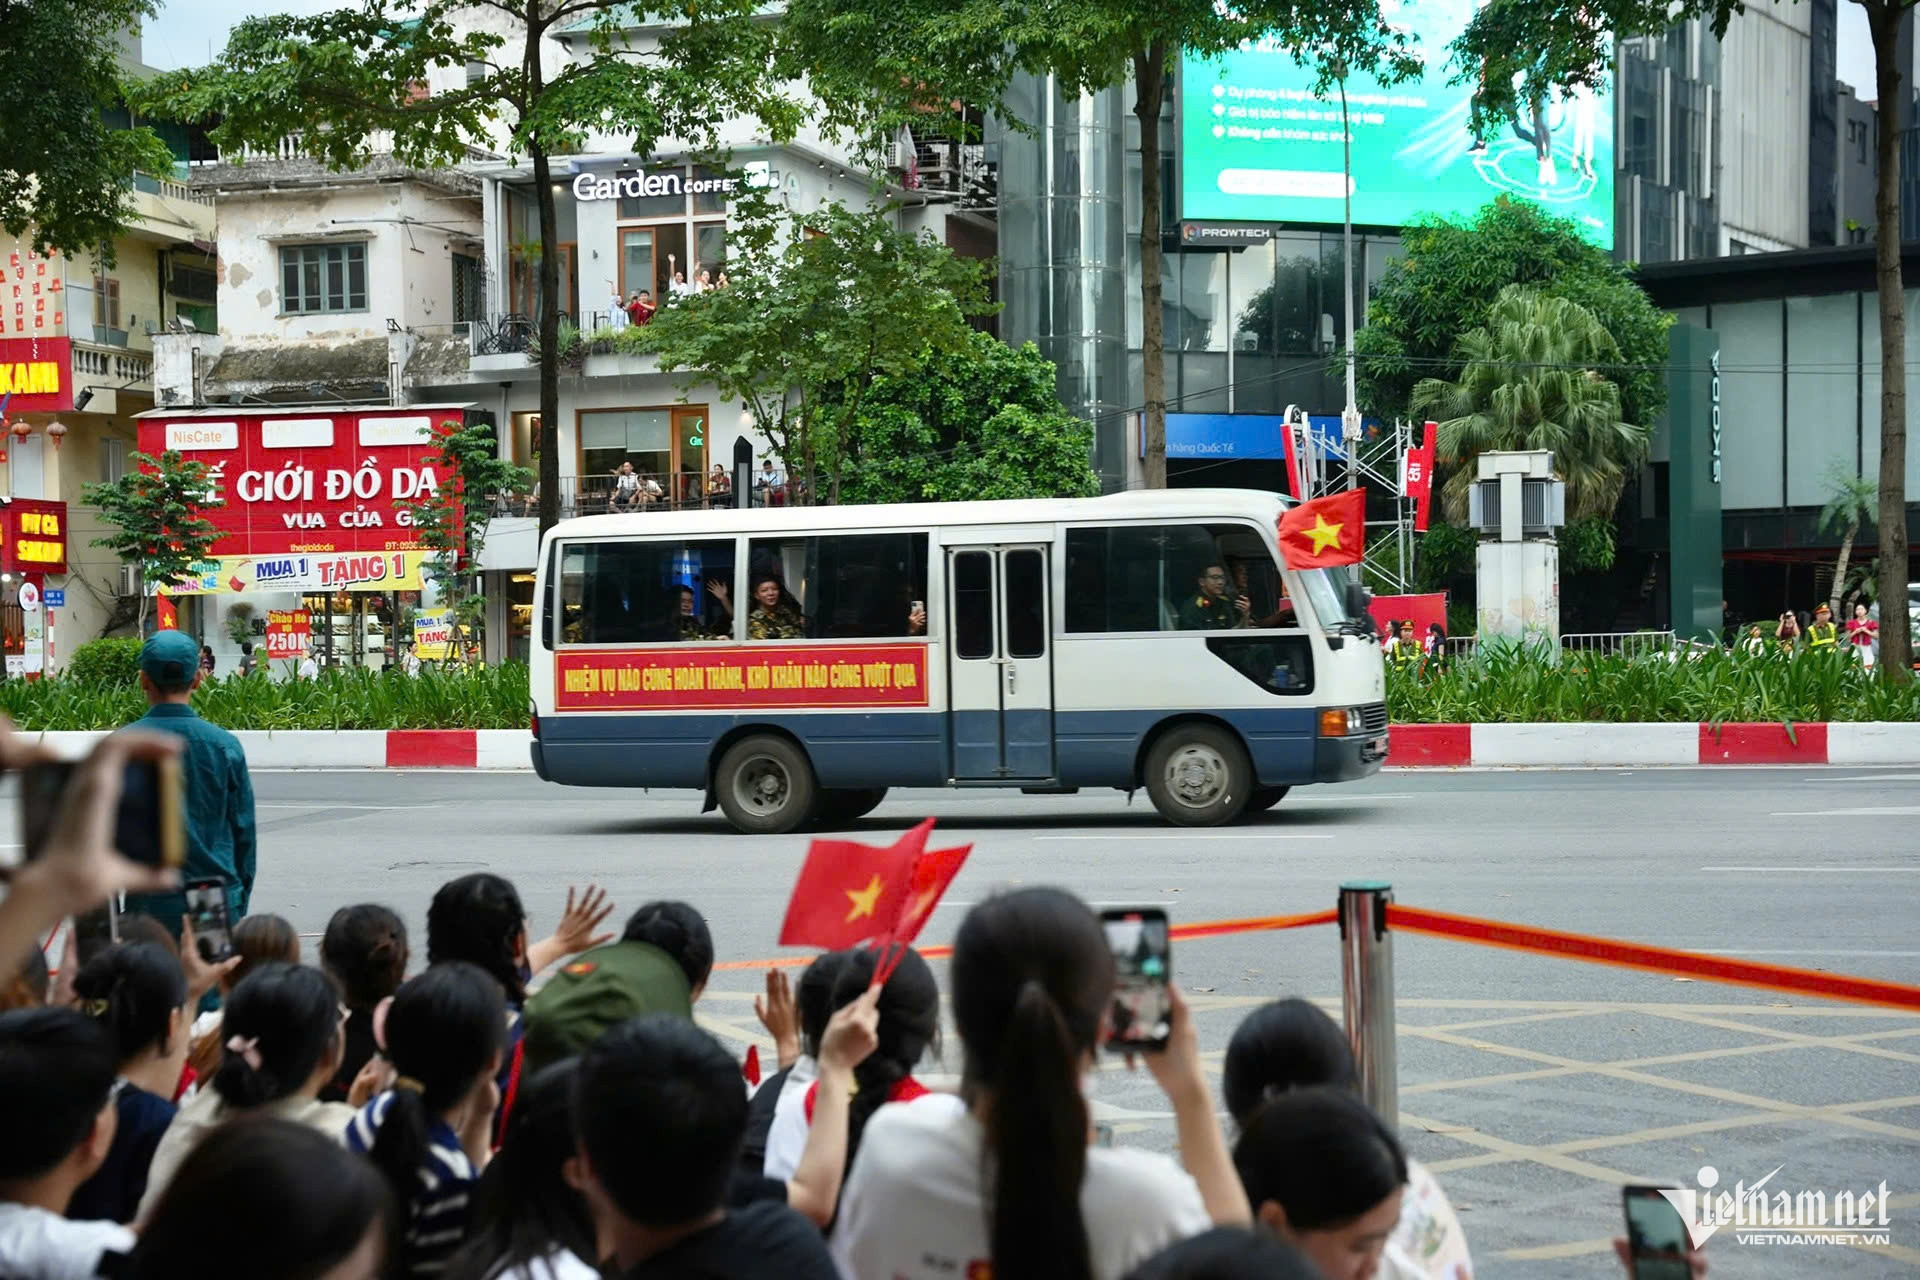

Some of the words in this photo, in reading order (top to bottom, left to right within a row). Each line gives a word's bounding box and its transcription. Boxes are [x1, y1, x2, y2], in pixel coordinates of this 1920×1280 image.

[573, 169, 682, 200] Garden
[1202, 229, 1270, 237] PROWTECH
[1197, 443, 1221, 454] Quốc
[237, 461, 313, 502] GIỚI
[324, 456, 382, 500] ĐỒ
[283, 512, 326, 528] VUA
[339, 505, 383, 528] CỦA
[256, 560, 294, 578] MUA
[298, 558, 307, 575] 1
[318, 556, 385, 588] TẶNG
[391, 554, 404, 576] 1
[416, 619, 434, 627] MUA
[268, 633, 307, 650] 250K
[565, 664, 599, 697] NHIỆM
[601, 668, 616, 697] VỤ
[618, 663, 641, 692] NÀO
[642, 663, 672, 691] CŨNG
[674, 662, 704, 690] HOÀN
[747, 660, 770, 689] KHÓ
[772, 660, 803, 689] KHĂN
[804, 660, 828, 689] NÀO
[830, 660, 861, 688] CŨNG
[894, 663, 917, 690] QUA
